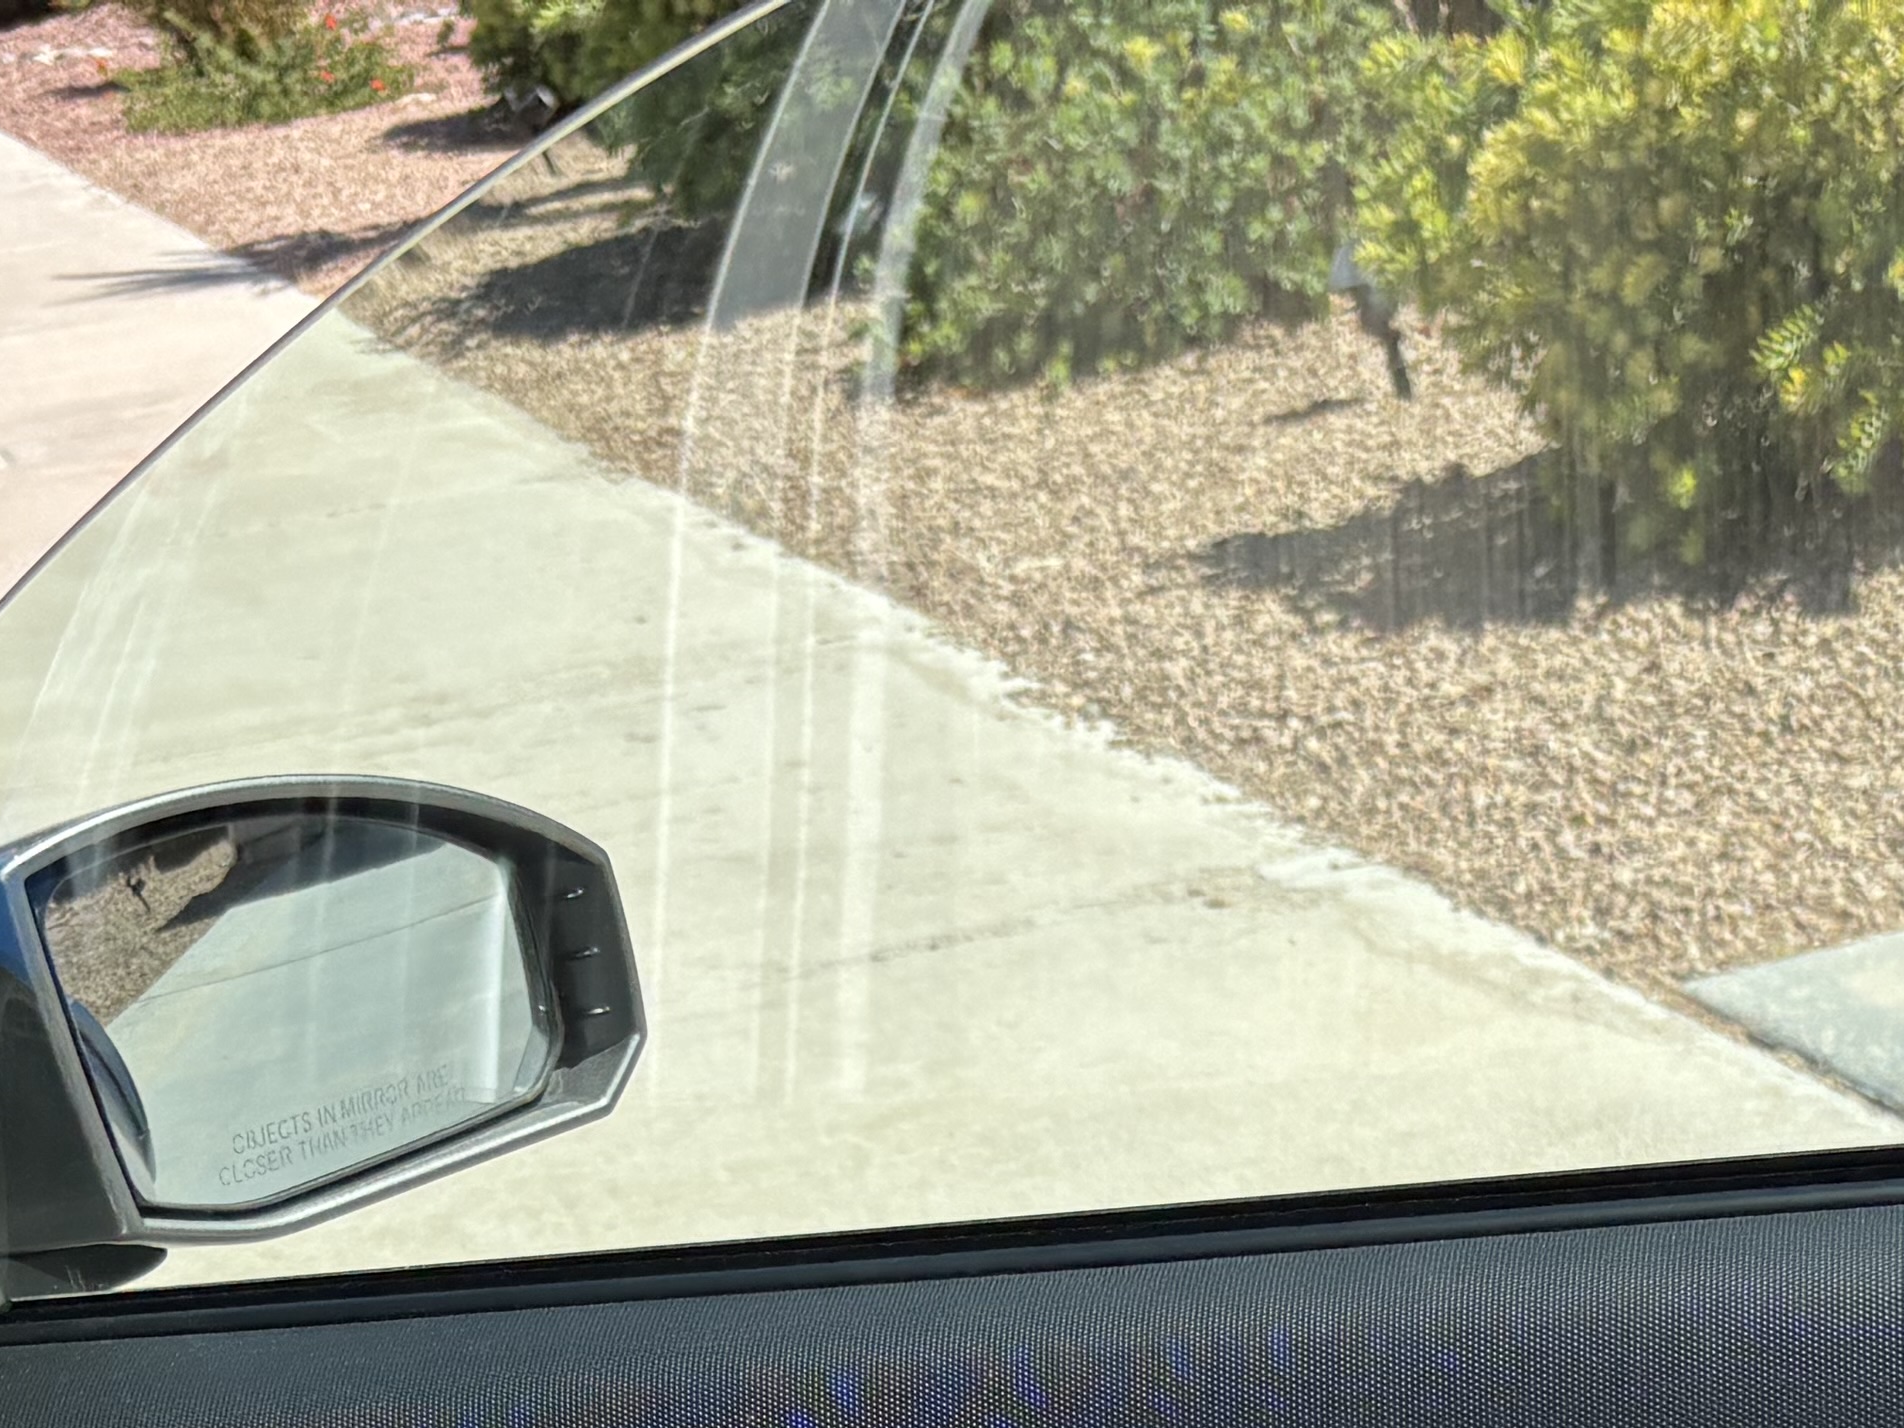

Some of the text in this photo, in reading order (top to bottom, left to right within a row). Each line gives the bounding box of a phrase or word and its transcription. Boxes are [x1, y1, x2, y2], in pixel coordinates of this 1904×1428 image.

[217, 1145, 294, 1187] CLOSER
[298, 1126, 347, 1161] THAN
[348, 1112, 395, 1143] THEY
[232, 1063, 450, 1155] OBJECTS IN MIRROR ARE
